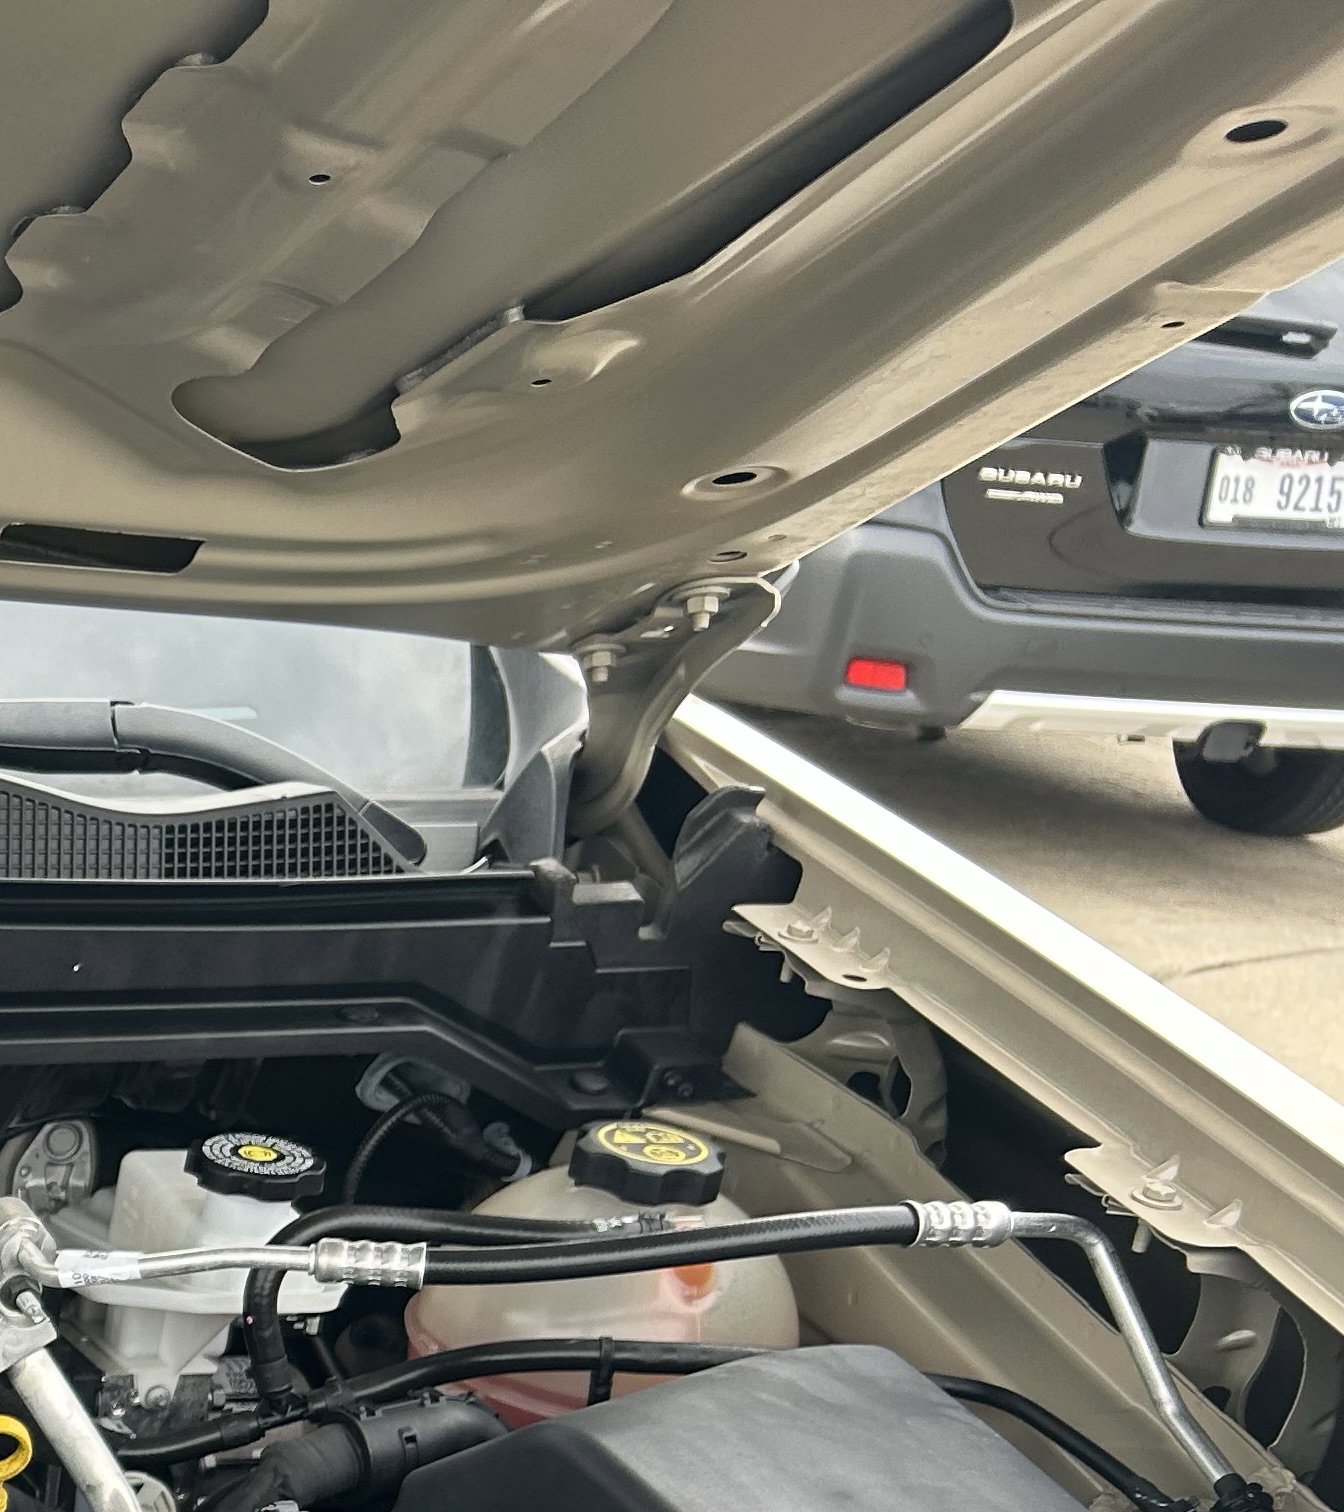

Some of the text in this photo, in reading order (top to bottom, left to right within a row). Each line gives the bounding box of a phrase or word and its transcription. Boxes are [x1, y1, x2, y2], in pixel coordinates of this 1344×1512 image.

[978, 467, 1083, 488] SUBARU
[1218, 473, 1344, 513] 018 9215
